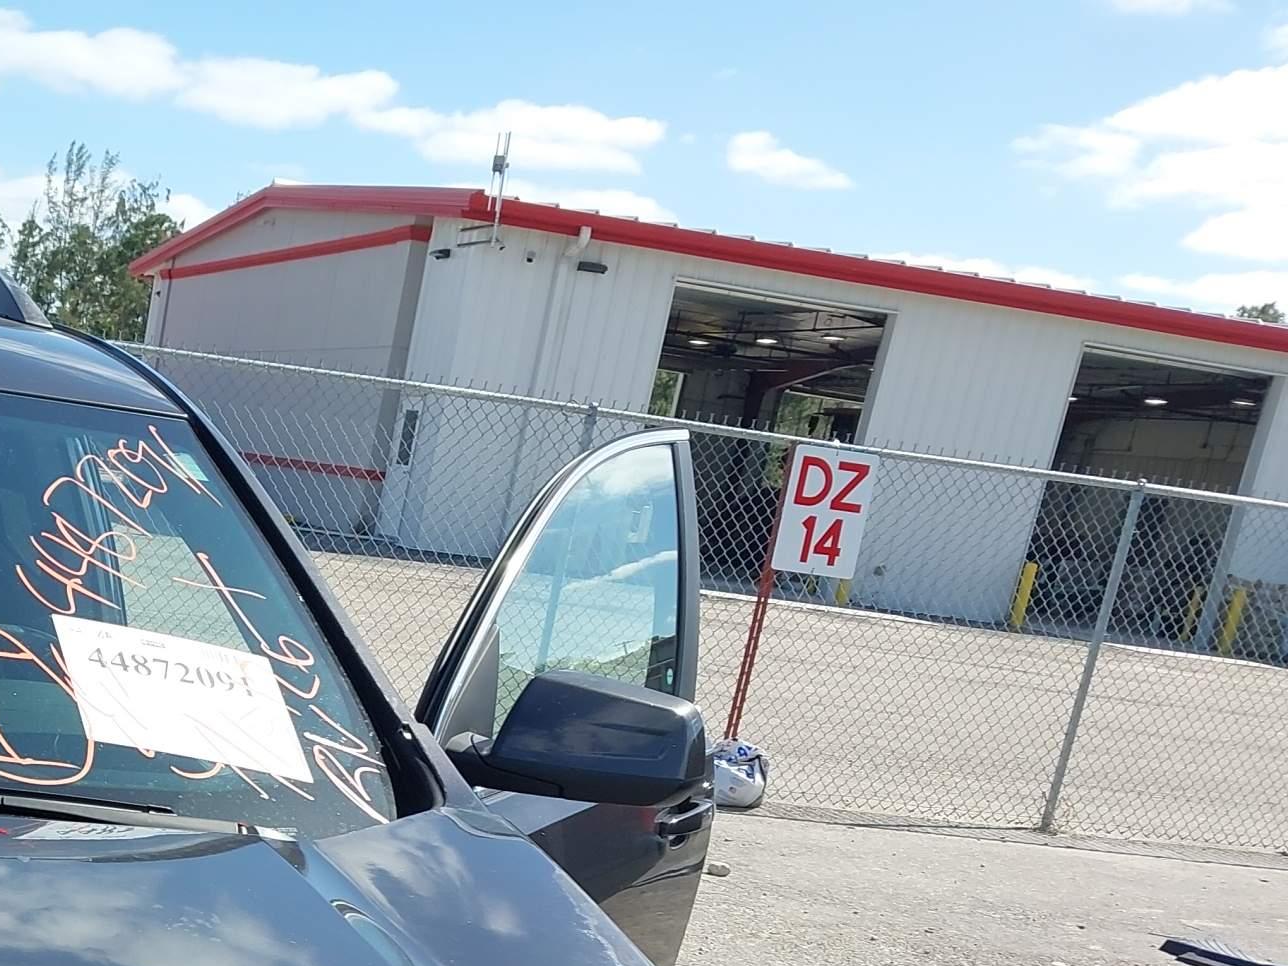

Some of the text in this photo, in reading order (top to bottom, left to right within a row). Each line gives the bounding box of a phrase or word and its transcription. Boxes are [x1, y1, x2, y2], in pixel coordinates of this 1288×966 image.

[793, 455, 871, 514] DZ
[800, 515, 844, 567] 14
[88, 647, 254, 697] 44872091
